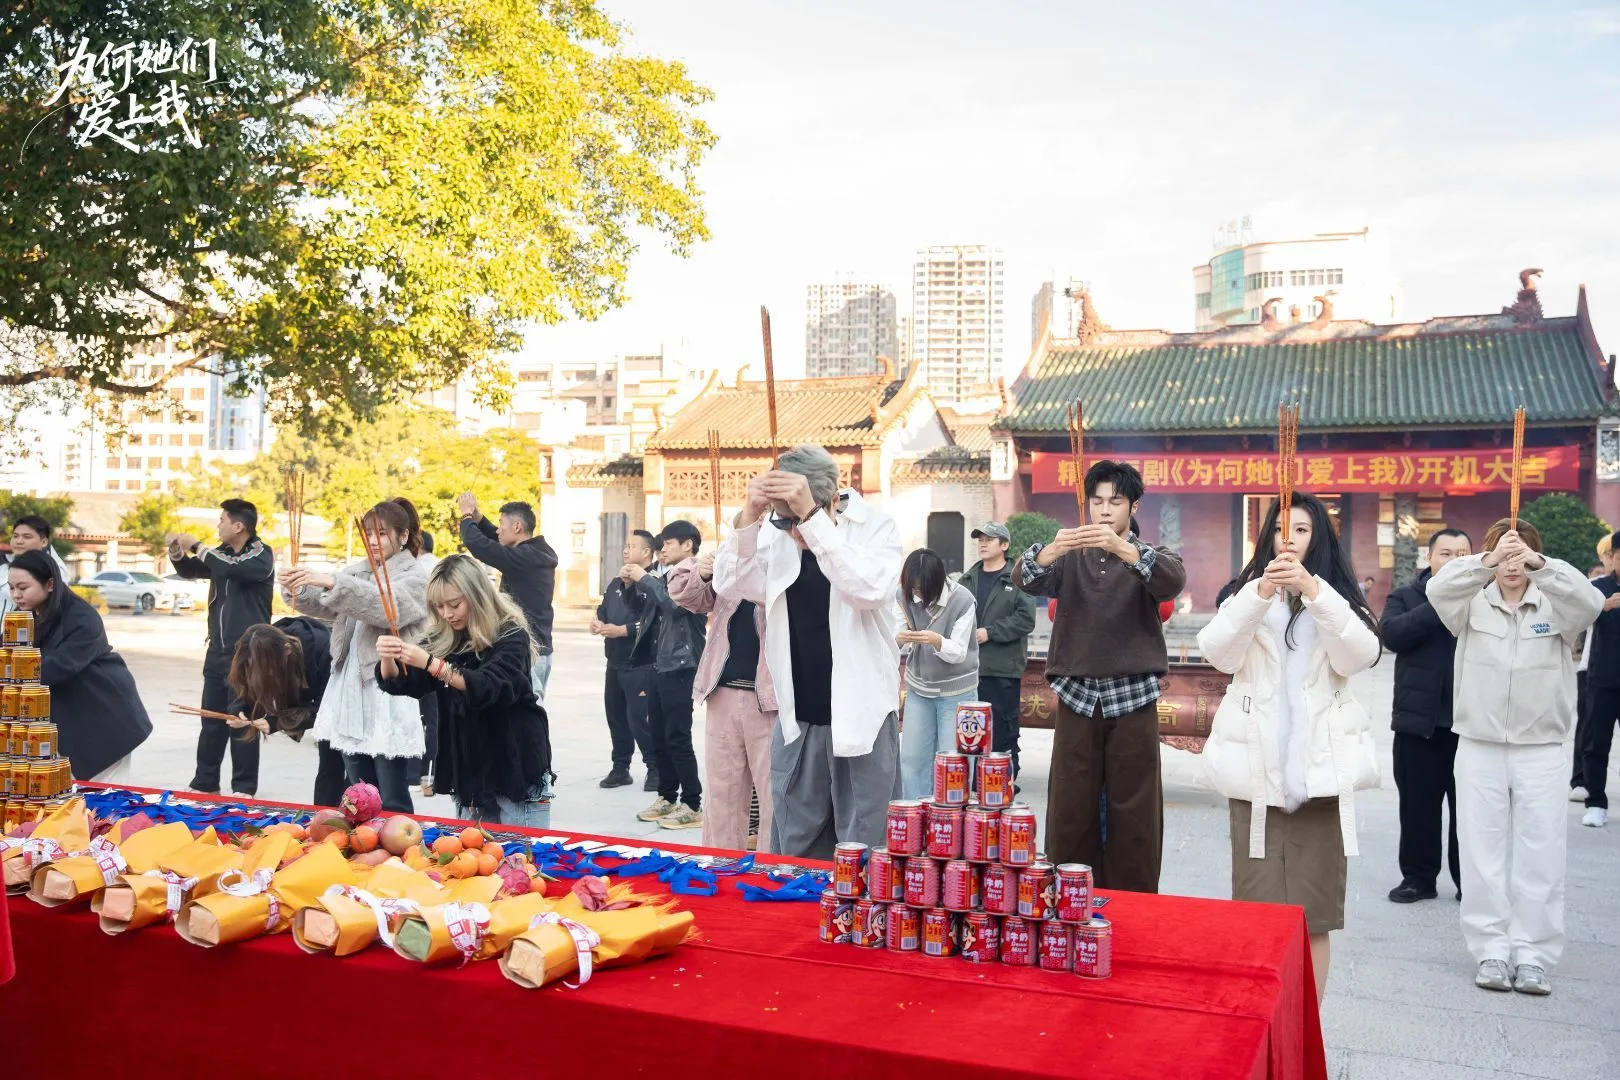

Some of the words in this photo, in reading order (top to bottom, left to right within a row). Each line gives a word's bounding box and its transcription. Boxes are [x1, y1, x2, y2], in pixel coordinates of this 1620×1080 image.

[1058, 455, 1548, 487] 精剧《为何她们爱上我》开机大吉
